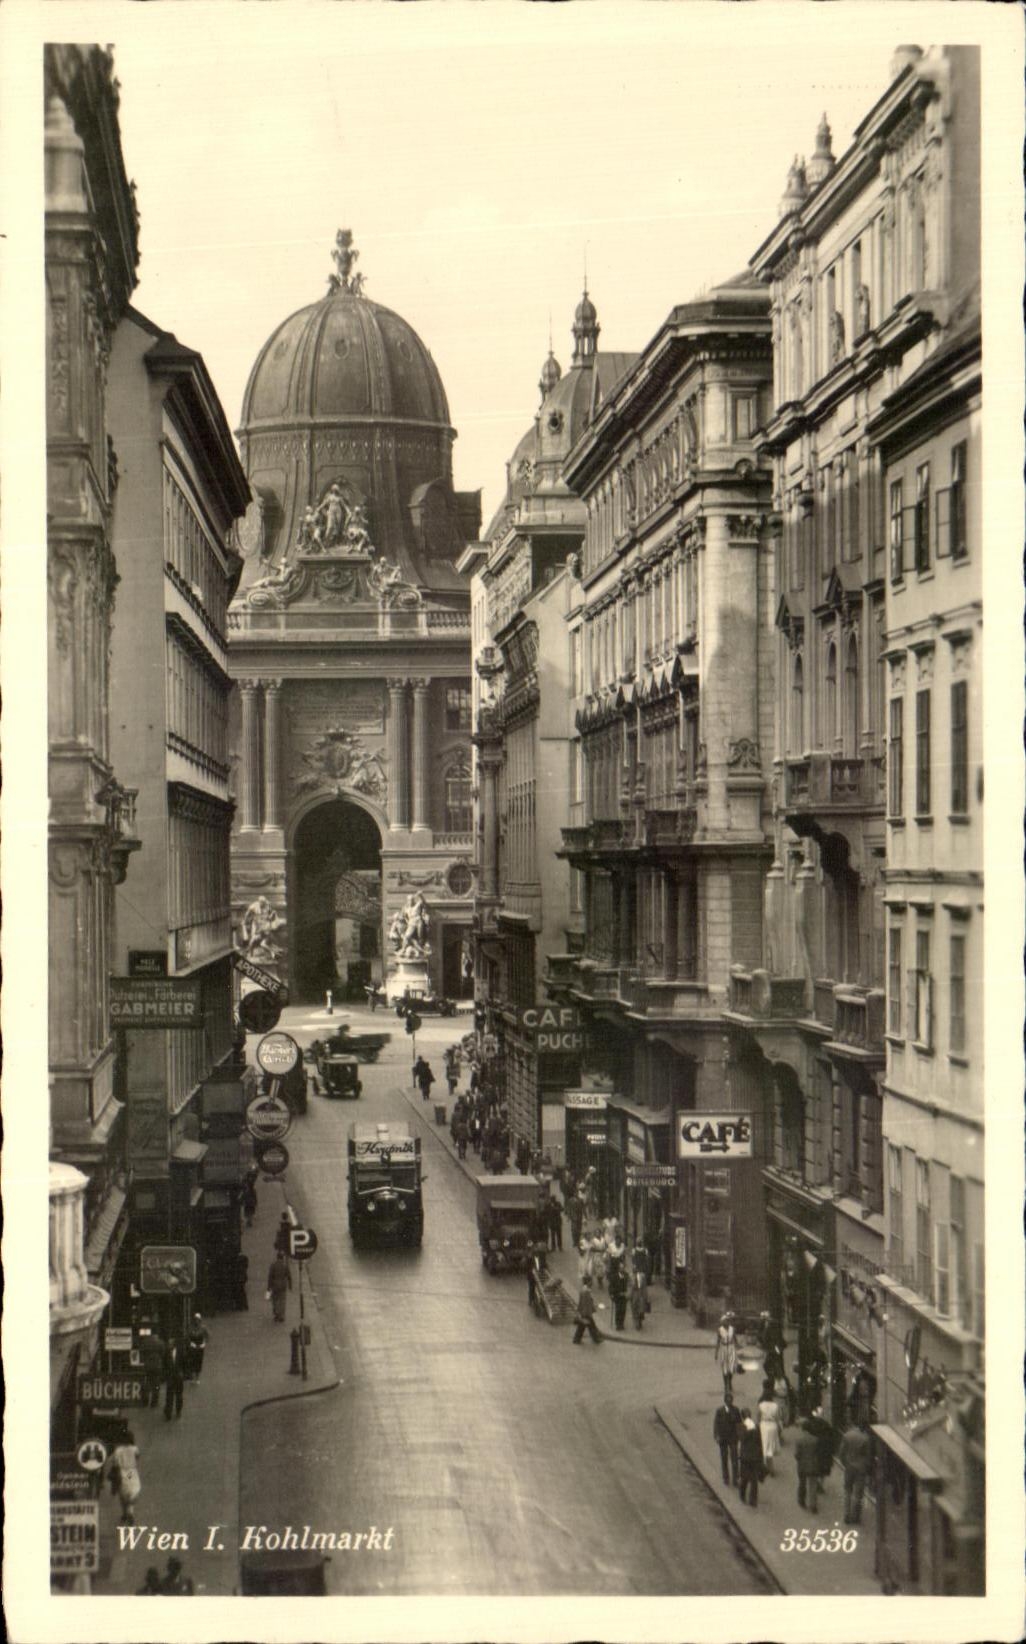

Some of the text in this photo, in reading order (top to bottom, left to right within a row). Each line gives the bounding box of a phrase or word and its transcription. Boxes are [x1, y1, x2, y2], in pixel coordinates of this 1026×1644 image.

[236, 960, 280, 993] APOTHEKE
[110, 1002, 195, 1015] GABMEIER
[682, 1117, 750, 1143] CAFÉ
[290, 1230, 310, 1255] P
[83, 1379, 142, 1400] BÜCHER
